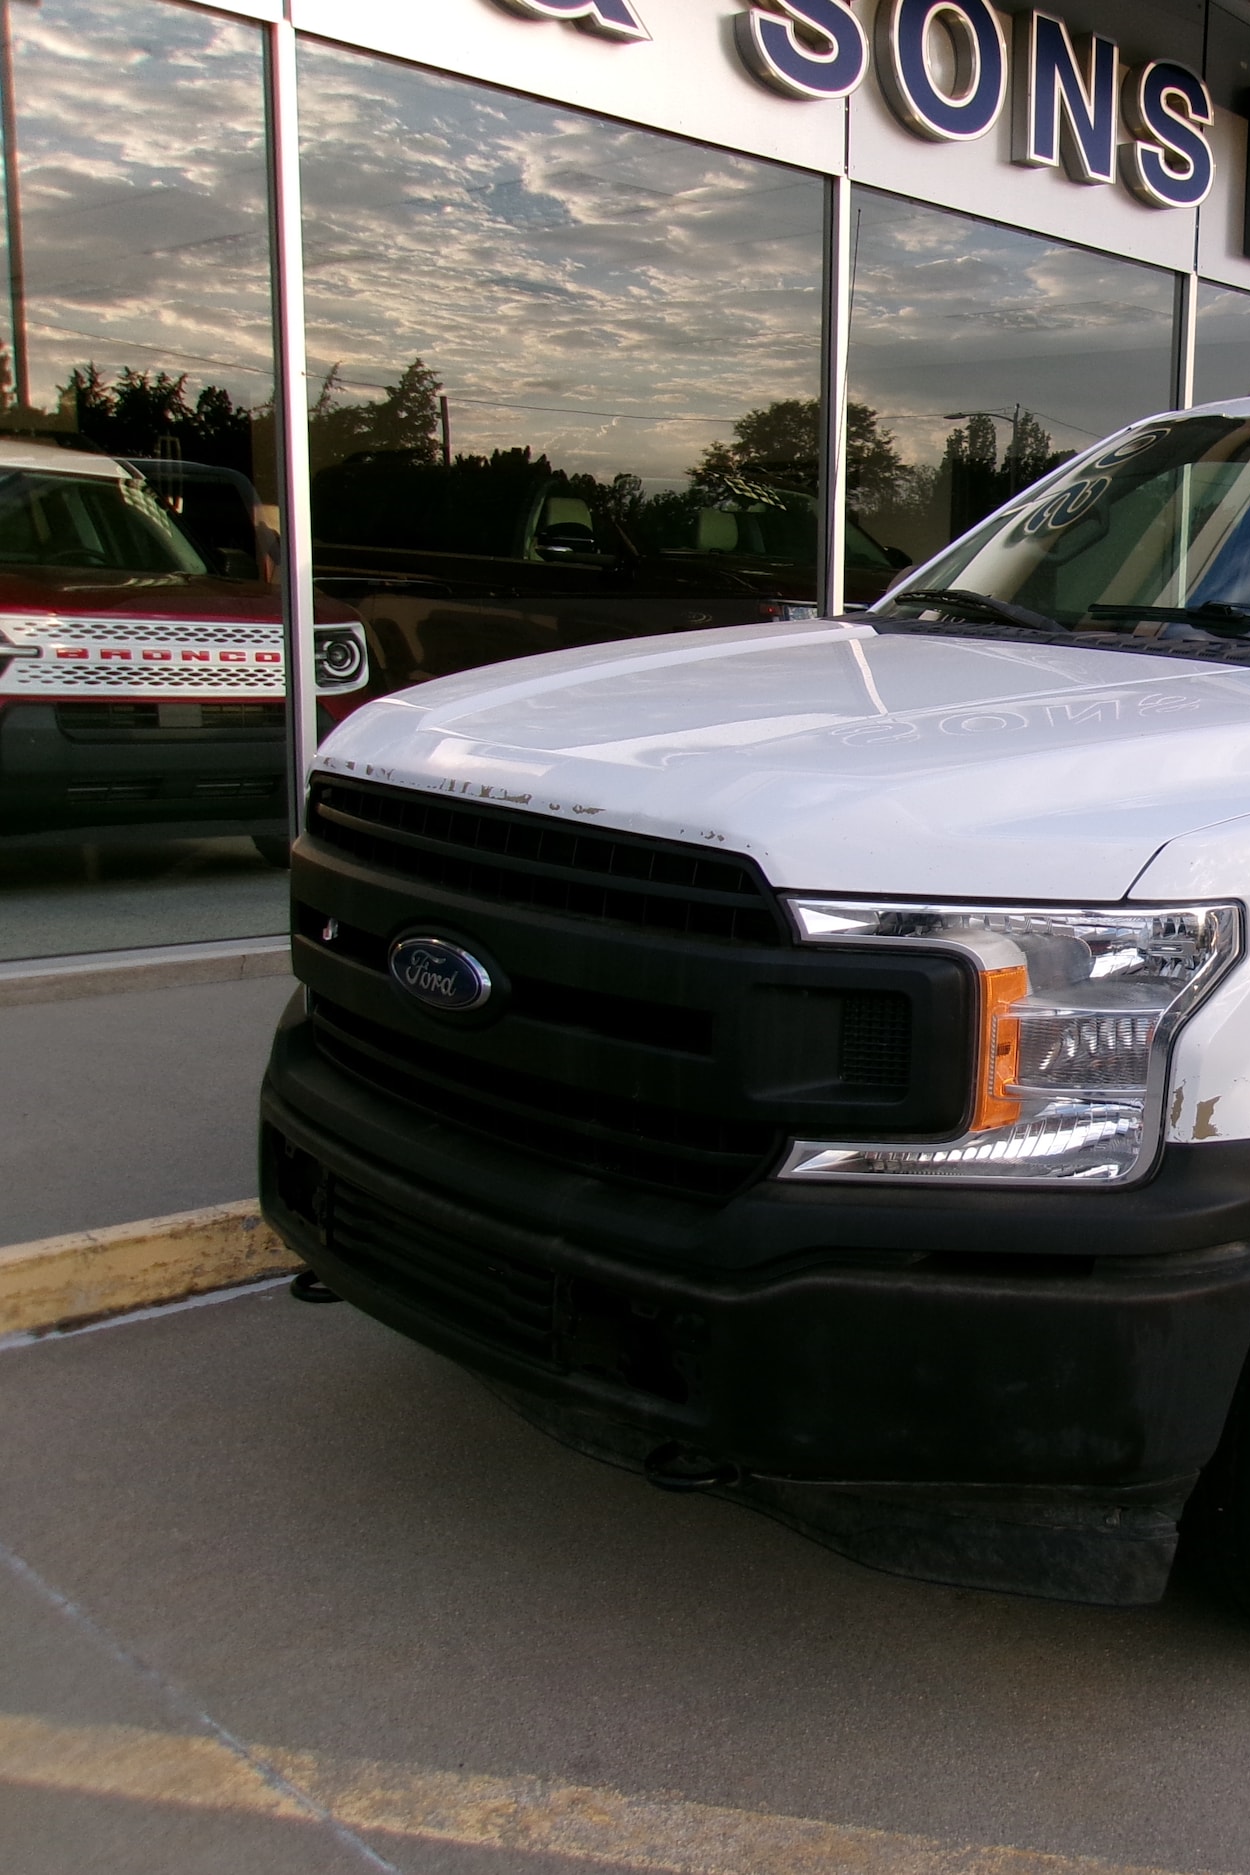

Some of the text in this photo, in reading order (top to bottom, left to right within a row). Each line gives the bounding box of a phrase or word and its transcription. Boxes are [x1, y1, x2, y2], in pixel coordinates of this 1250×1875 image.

[733, 0, 1216, 209] SONS
[56, 647, 281, 662] BRONCO
[405, 949, 459, 997] Ford
